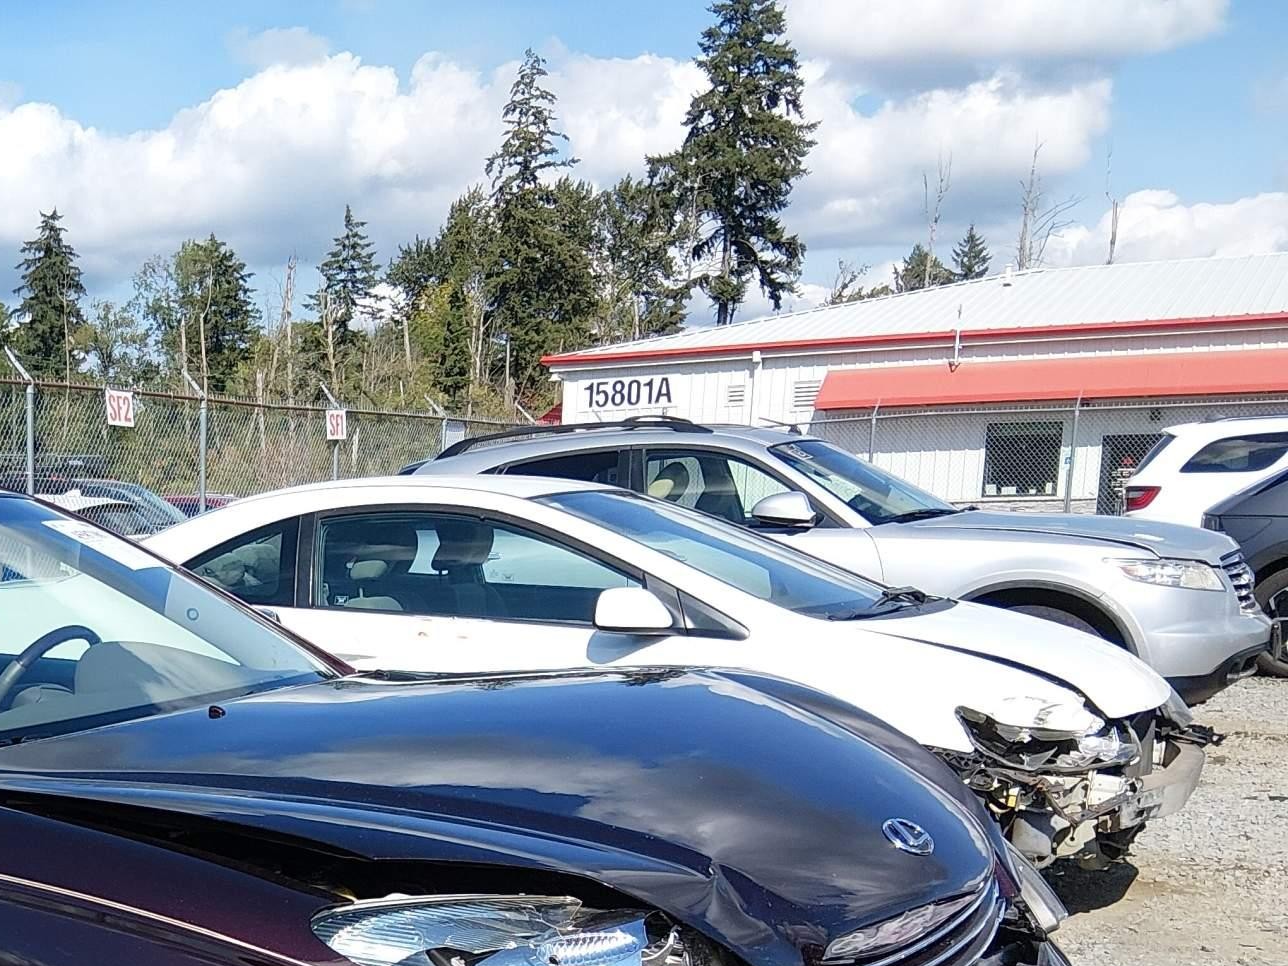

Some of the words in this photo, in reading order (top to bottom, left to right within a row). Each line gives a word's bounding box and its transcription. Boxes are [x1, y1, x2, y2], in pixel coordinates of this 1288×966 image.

[583, 377, 672, 409] 15801A
[108, 394, 132, 422] SF2
[329, 413, 344, 436] SF1
